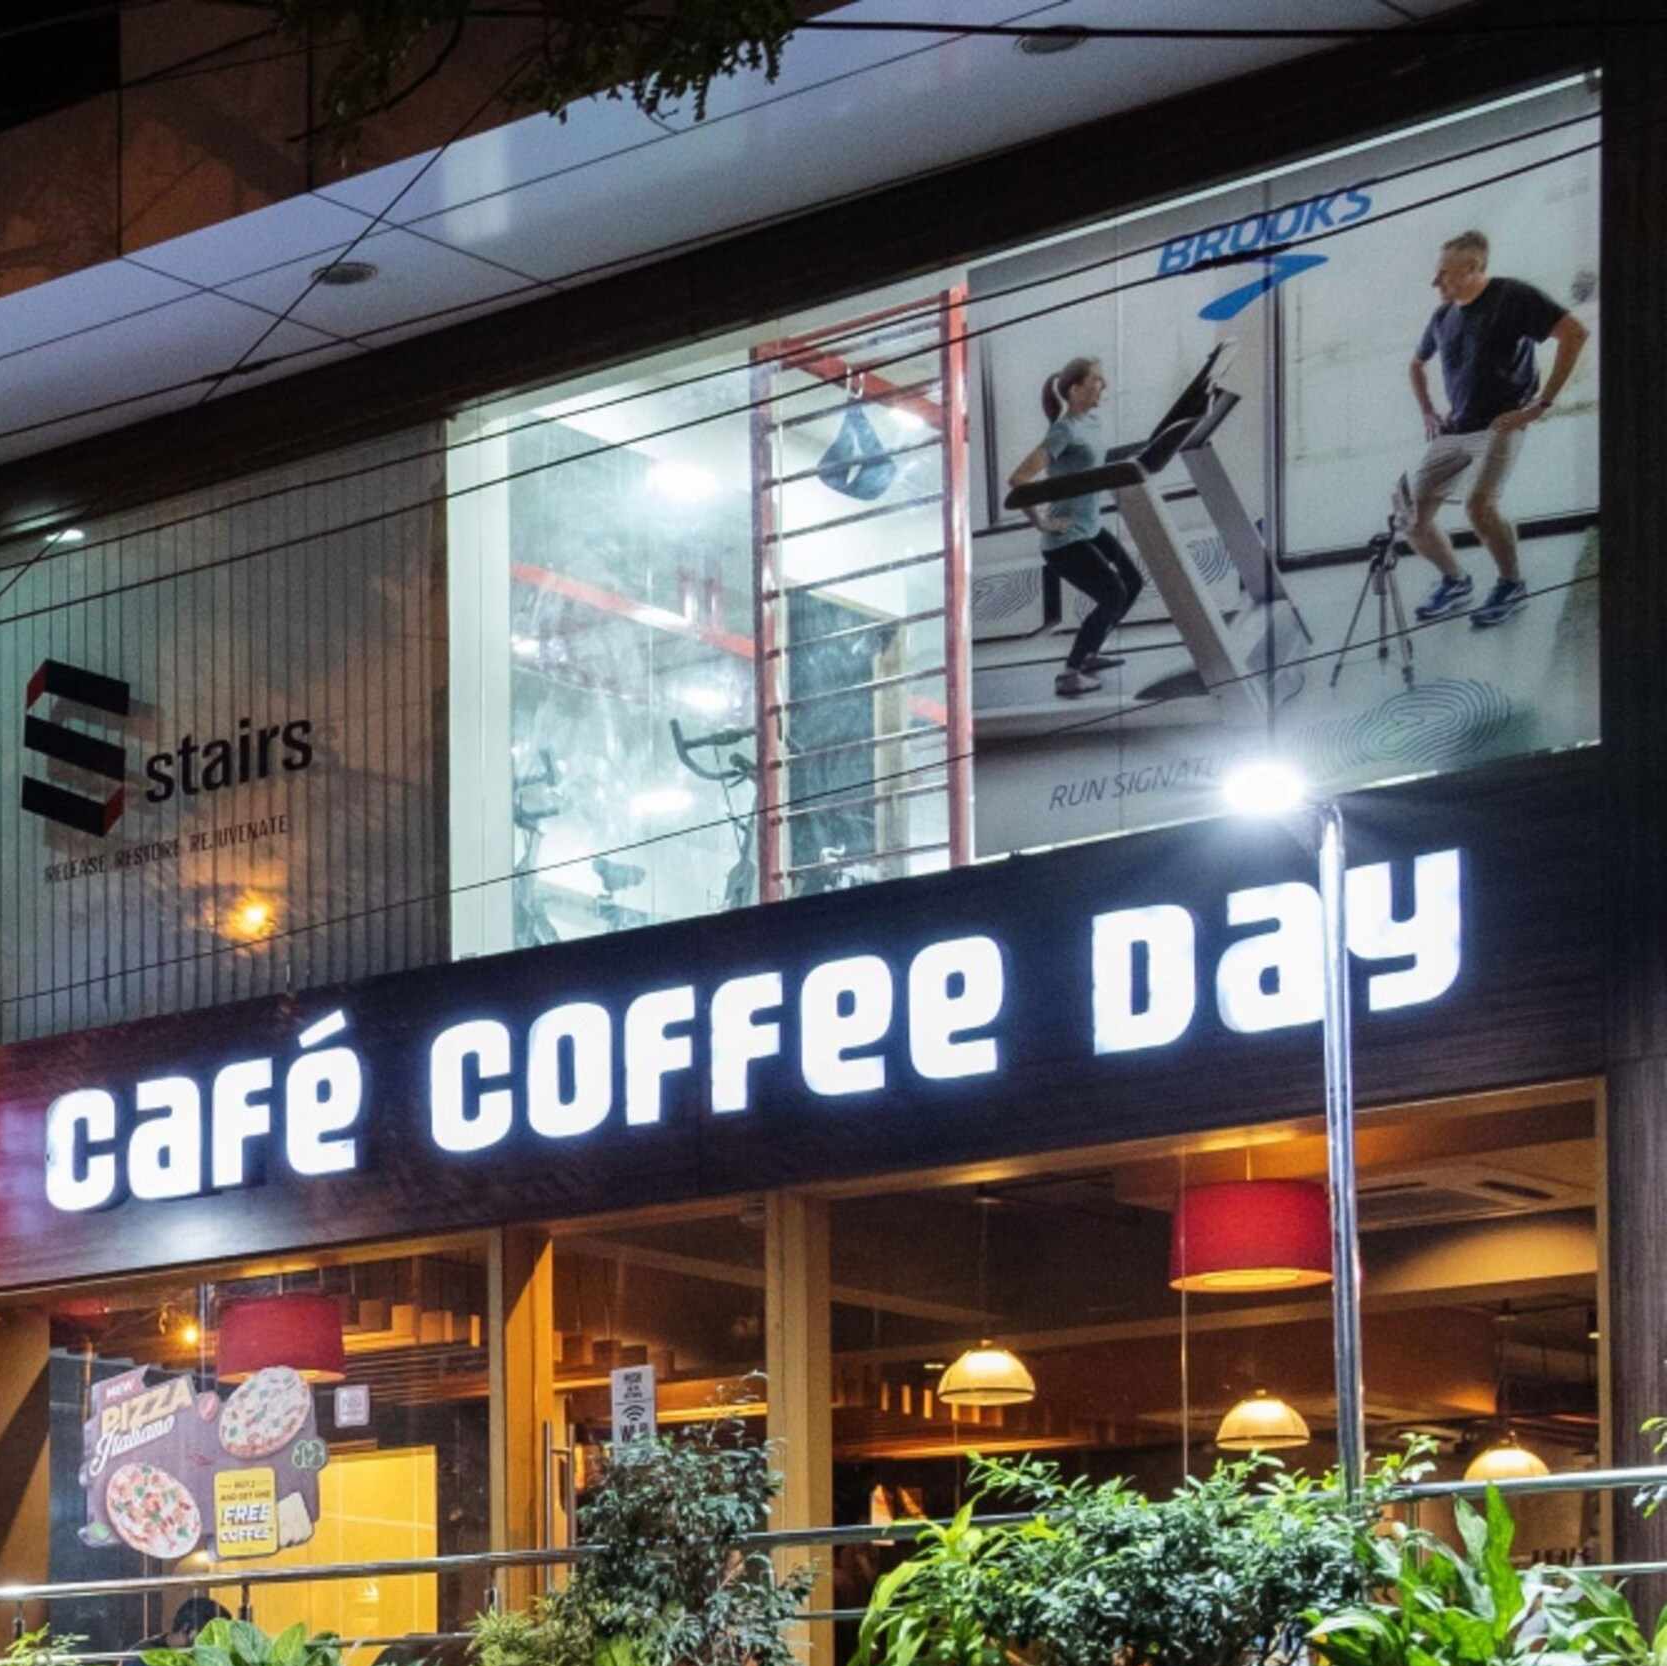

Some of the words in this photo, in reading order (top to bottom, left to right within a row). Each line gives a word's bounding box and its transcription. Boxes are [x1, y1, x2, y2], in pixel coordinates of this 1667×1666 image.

[1156, 188, 1374, 277] BROOKS
[145, 717, 314, 804] stairs
[1049, 777, 1108, 812] RUN
[44, 854, 107, 884] RELEASE
[114, 836, 182, 868] RESTORE
[189, 814, 288, 851] REJUVENATE
[101, 1377, 194, 1438] PIZZA
[105, 1379, 135, 1400] NEW
[221, 1504, 273, 1526] FREE
